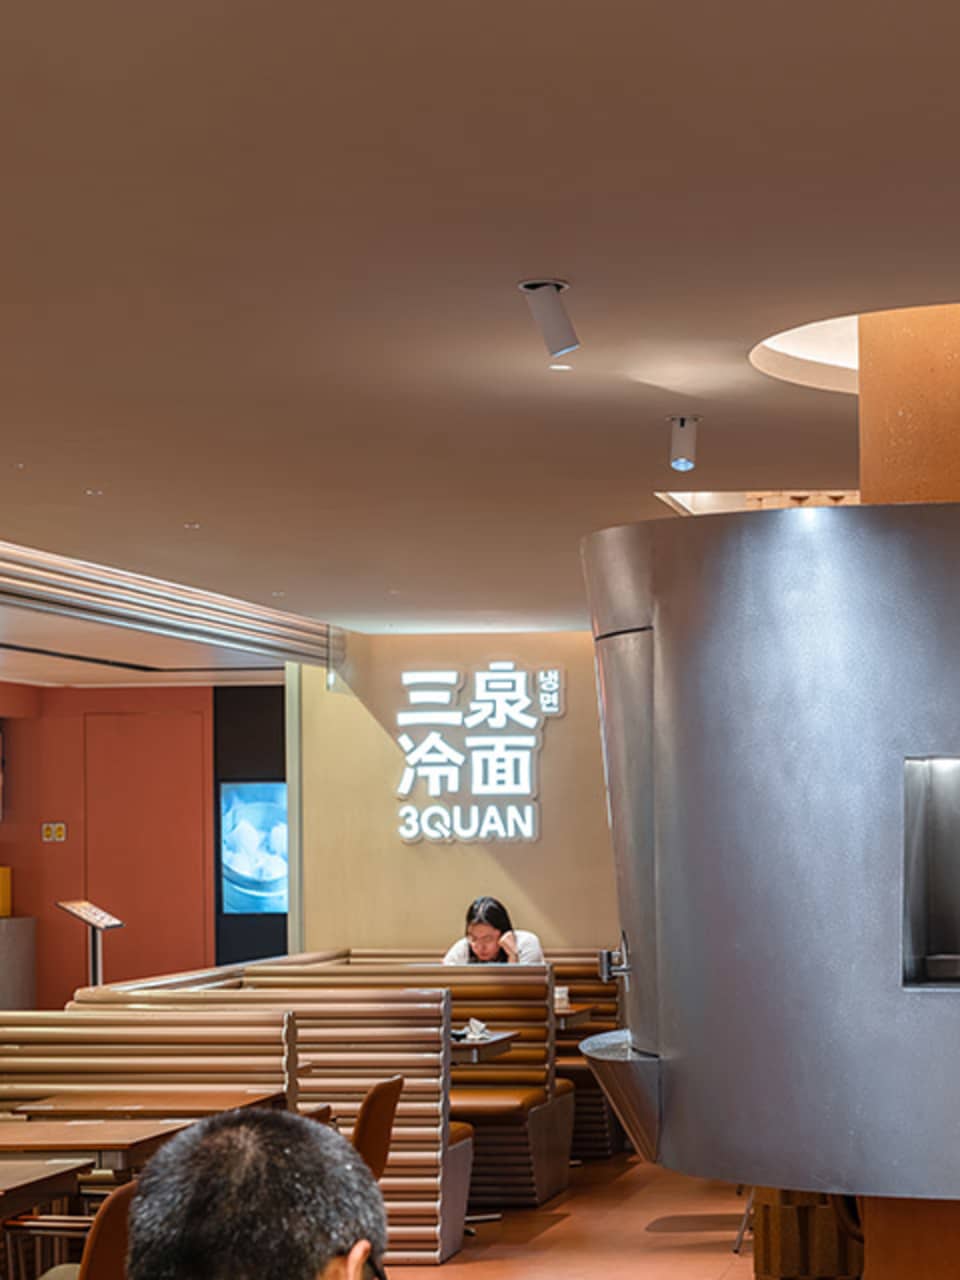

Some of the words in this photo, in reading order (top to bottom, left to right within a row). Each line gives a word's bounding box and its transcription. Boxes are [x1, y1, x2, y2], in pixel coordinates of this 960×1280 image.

[397, 661, 538, 729] 三泉
[397, 731, 537, 797] 冷面
[398, 804, 534, 839] 3QUAN
